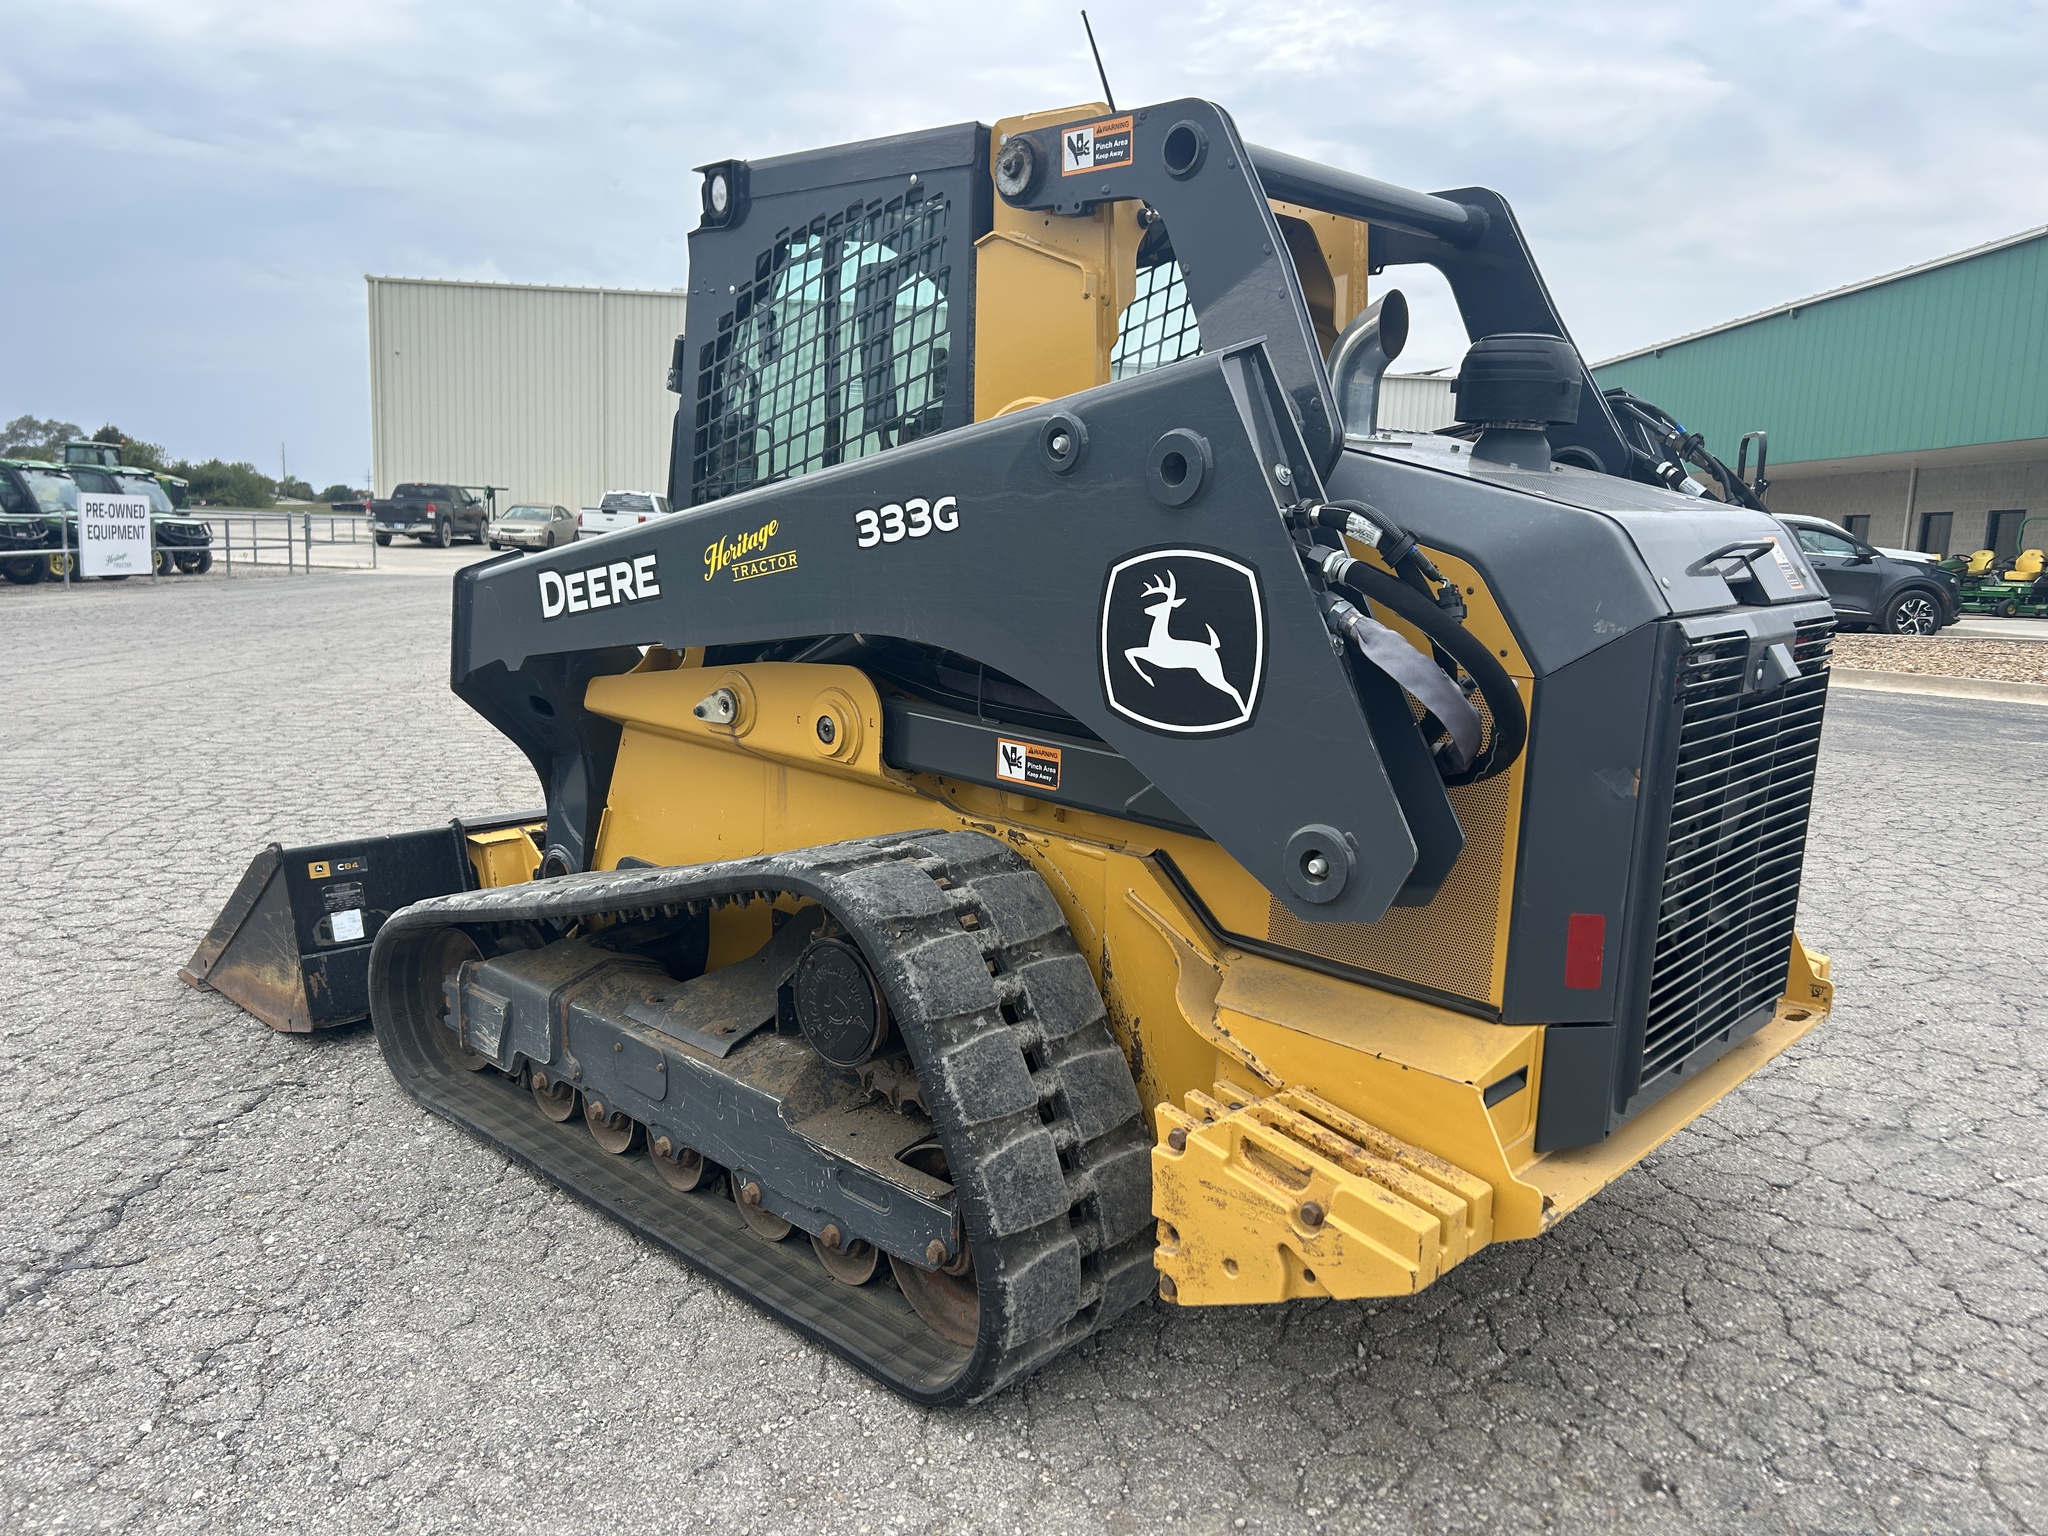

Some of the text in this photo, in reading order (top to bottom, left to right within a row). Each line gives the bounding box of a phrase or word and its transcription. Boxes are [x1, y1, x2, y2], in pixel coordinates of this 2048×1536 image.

[1102, 120, 1130, 133] WARNING
[1095, 139, 1129, 151] Pinch Area
[1109, 150, 1124, 158] Away
[85, 502, 146, 520] PRE-OWNED
[855, 496, 959, 547] 333G
[87, 524, 146, 541] EQUIPMENT
[704, 519, 779, 581] Heritage
[731, 553, 798, 578] TRACTOR
[538, 554, 660, 618] DEERE
[1032, 749, 1058, 759] WARNING
[1027, 761, 1057, 774] Pinch Area
[337, 862, 359, 871] C84
